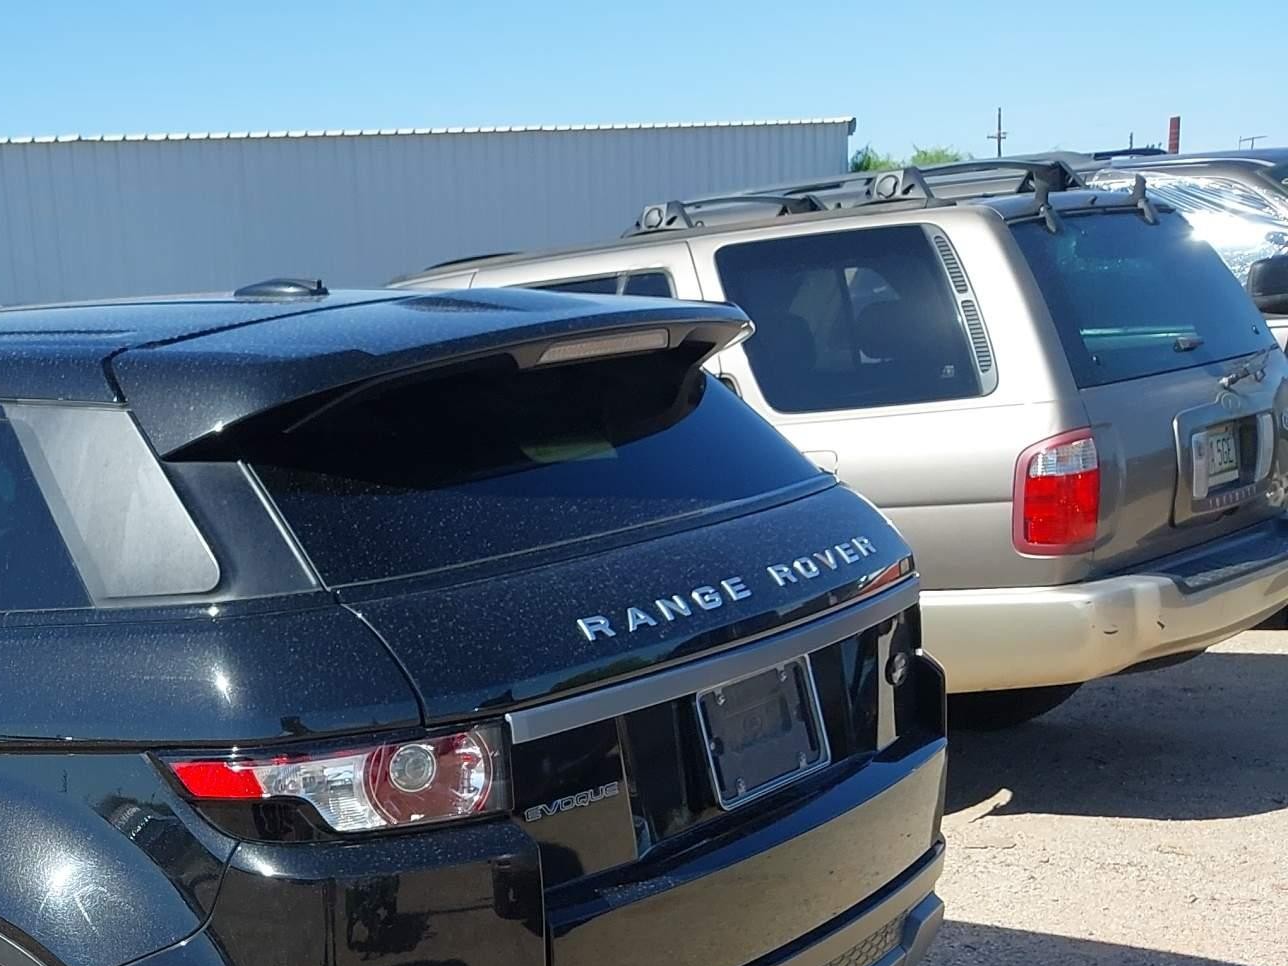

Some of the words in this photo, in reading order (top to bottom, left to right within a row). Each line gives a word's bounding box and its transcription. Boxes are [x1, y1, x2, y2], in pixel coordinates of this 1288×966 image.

[578, 577, 751, 641] RANGE
[767, 536, 876, 586] ROVER
[524, 781, 619, 821] EVOQUE
